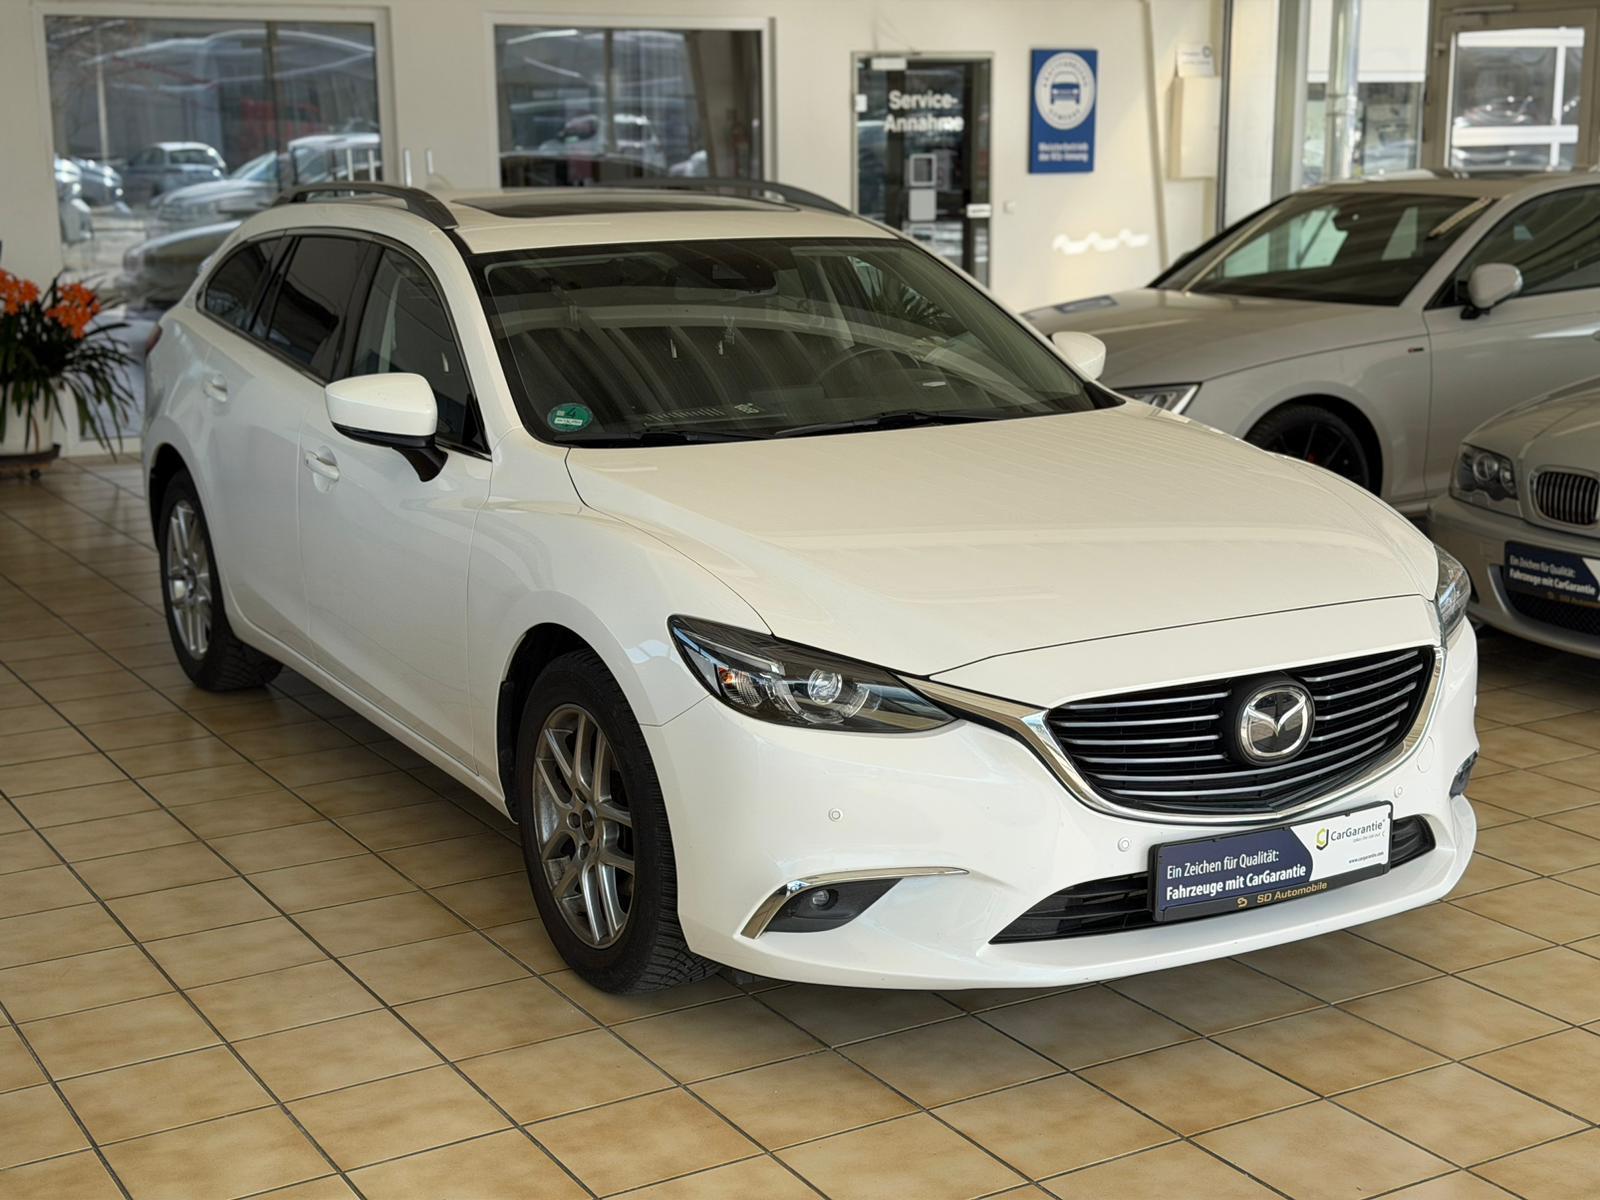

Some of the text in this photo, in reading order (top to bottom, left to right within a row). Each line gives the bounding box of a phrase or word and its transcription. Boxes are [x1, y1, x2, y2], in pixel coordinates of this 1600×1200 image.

[888, 90, 959, 109] Service-
[1330, 820, 1383, 841] CarGarantie
[1167, 849, 1280, 880] Ein Zeichen für Qualität:
[1166, 863, 1307, 901] Fahrzeuge mit CarGarantie
[1256, 881, 1328, 904] SD Automobile
